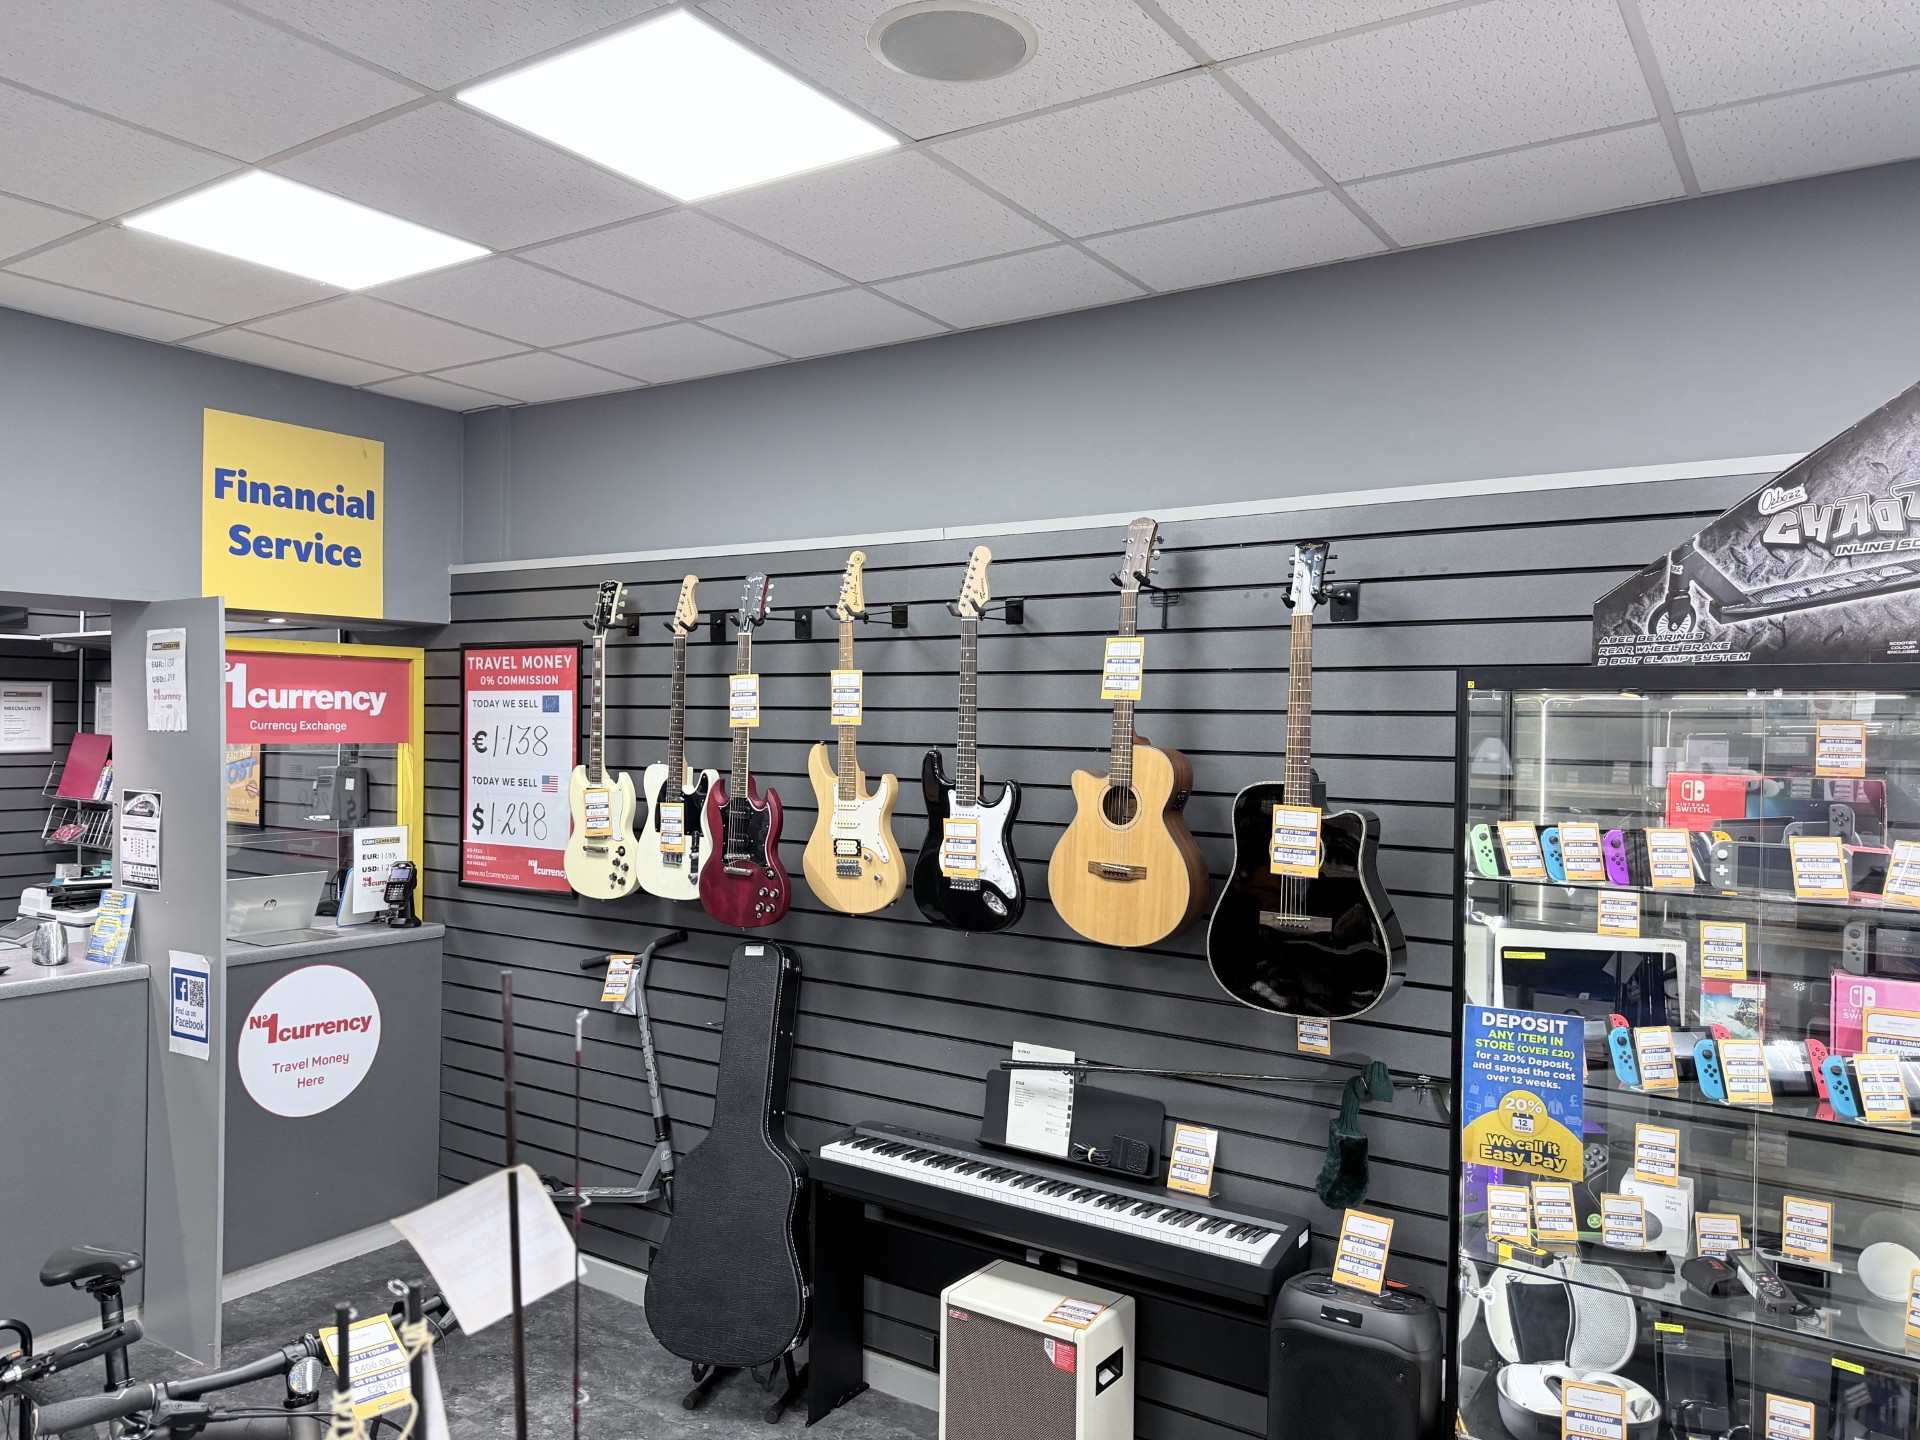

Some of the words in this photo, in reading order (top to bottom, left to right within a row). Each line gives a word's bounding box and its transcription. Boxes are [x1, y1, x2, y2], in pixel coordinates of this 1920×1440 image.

[214, 467, 375, 520] Financial
[228, 524, 362, 568] Service
[1836, 542, 1893, 556] INLINE
[1600, 635, 1634, 644] ABEC
[1637, 632, 1703, 643] BEARINGS
[1599, 646, 1634, 655] REAR
[1637, 644, 1679, 654] WHEEL
[1681, 642, 1730, 652] BRAKE
[467, 656, 518, 670] TRAVEL
[522, 654, 573, 669] MONEY
[1610, 657, 1641, 665] BOLT
[1644, 655, 1689, 664] CLAMP
[1692, 652, 1750, 662] SYSTEM
[480, 675, 495, 686] 0%
[497, 675, 559, 686] COMMISSION
[472, 699, 500, 708] TODAY
[502, 699, 516, 708] WE
[518, 699, 538, 708] SELL
[250, 720, 297, 732] Currency
[300, 720, 347, 733] Exchange
[472, 776, 500, 786] TODAY
[502, 776, 516, 786] WE
[518, 777, 538, 788] SELL
[1676, 806, 1711, 814] SWITCH
[175, 1006, 184, 1015] Find
[175, 1016, 204, 1031] Facebook
[1482, 1012, 1568, 1035] DEPOSIT
[1488, 1030, 1516, 1041] ANY
[1517, 1032, 1548, 1045] ITEM
[1550, 1036, 1564, 1047] IN
[1899, 1039, 1920, 1048] TODAY
[1475, 1038, 1514, 1051] STORE
[1517, 1044, 1549, 1056] (OVER
[1551, 1048, 1575, 1060] £20)
[272, 1058, 308, 1074] Travel
[312, 1054, 350, 1068] Money
[1476, 1050, 1492, 1060] for
[1502, 1054, 1526, 1064] 20%
[1528, 1057, 1573, 1071] Deposit,
[1472, 1060, 1492, 1070] and
[1494, 1064, 1530, 1076] spread
[1532, 1068, 1550, 1078] the
[1553, 1072, 1576, 1082] cost
[297, 1076, 324, 1088] Here
[1486, 1074, 1509, 1083] over
[1512, 1076, 1523, 1084] 12
[1525, 1079, 1562, 1090] weeks.
[1504, 1097, 1543, 1114] 20%
[1486, 1133, 1514, 1148] We
[1516, 1139, 1543, 1150] call
[1547, 1142, 1560, 1156] it
[1480, 1144, 1526, 1167] Easy
[1530, 1153, 1568, 1173] Pay
[1364, 1240, 1379, 1248] TODAY
[1352, 1265, 1369, 1275] £7.33
[1360, 1259, 1377, 1268] WEEKLY
[368, 1346, 390, 1357] TODAY
[354, 1357, 391, 1374] £400.00
[364, 1376, 377, 1384] PAY
[378, 1367, 404, 1381] WEEKLY
[367, 1379, 398, 1394] £26.67
[1594, 1415, 1614, 1424] TODAY
[1579, 1424, 1608, 1435] £80.00
